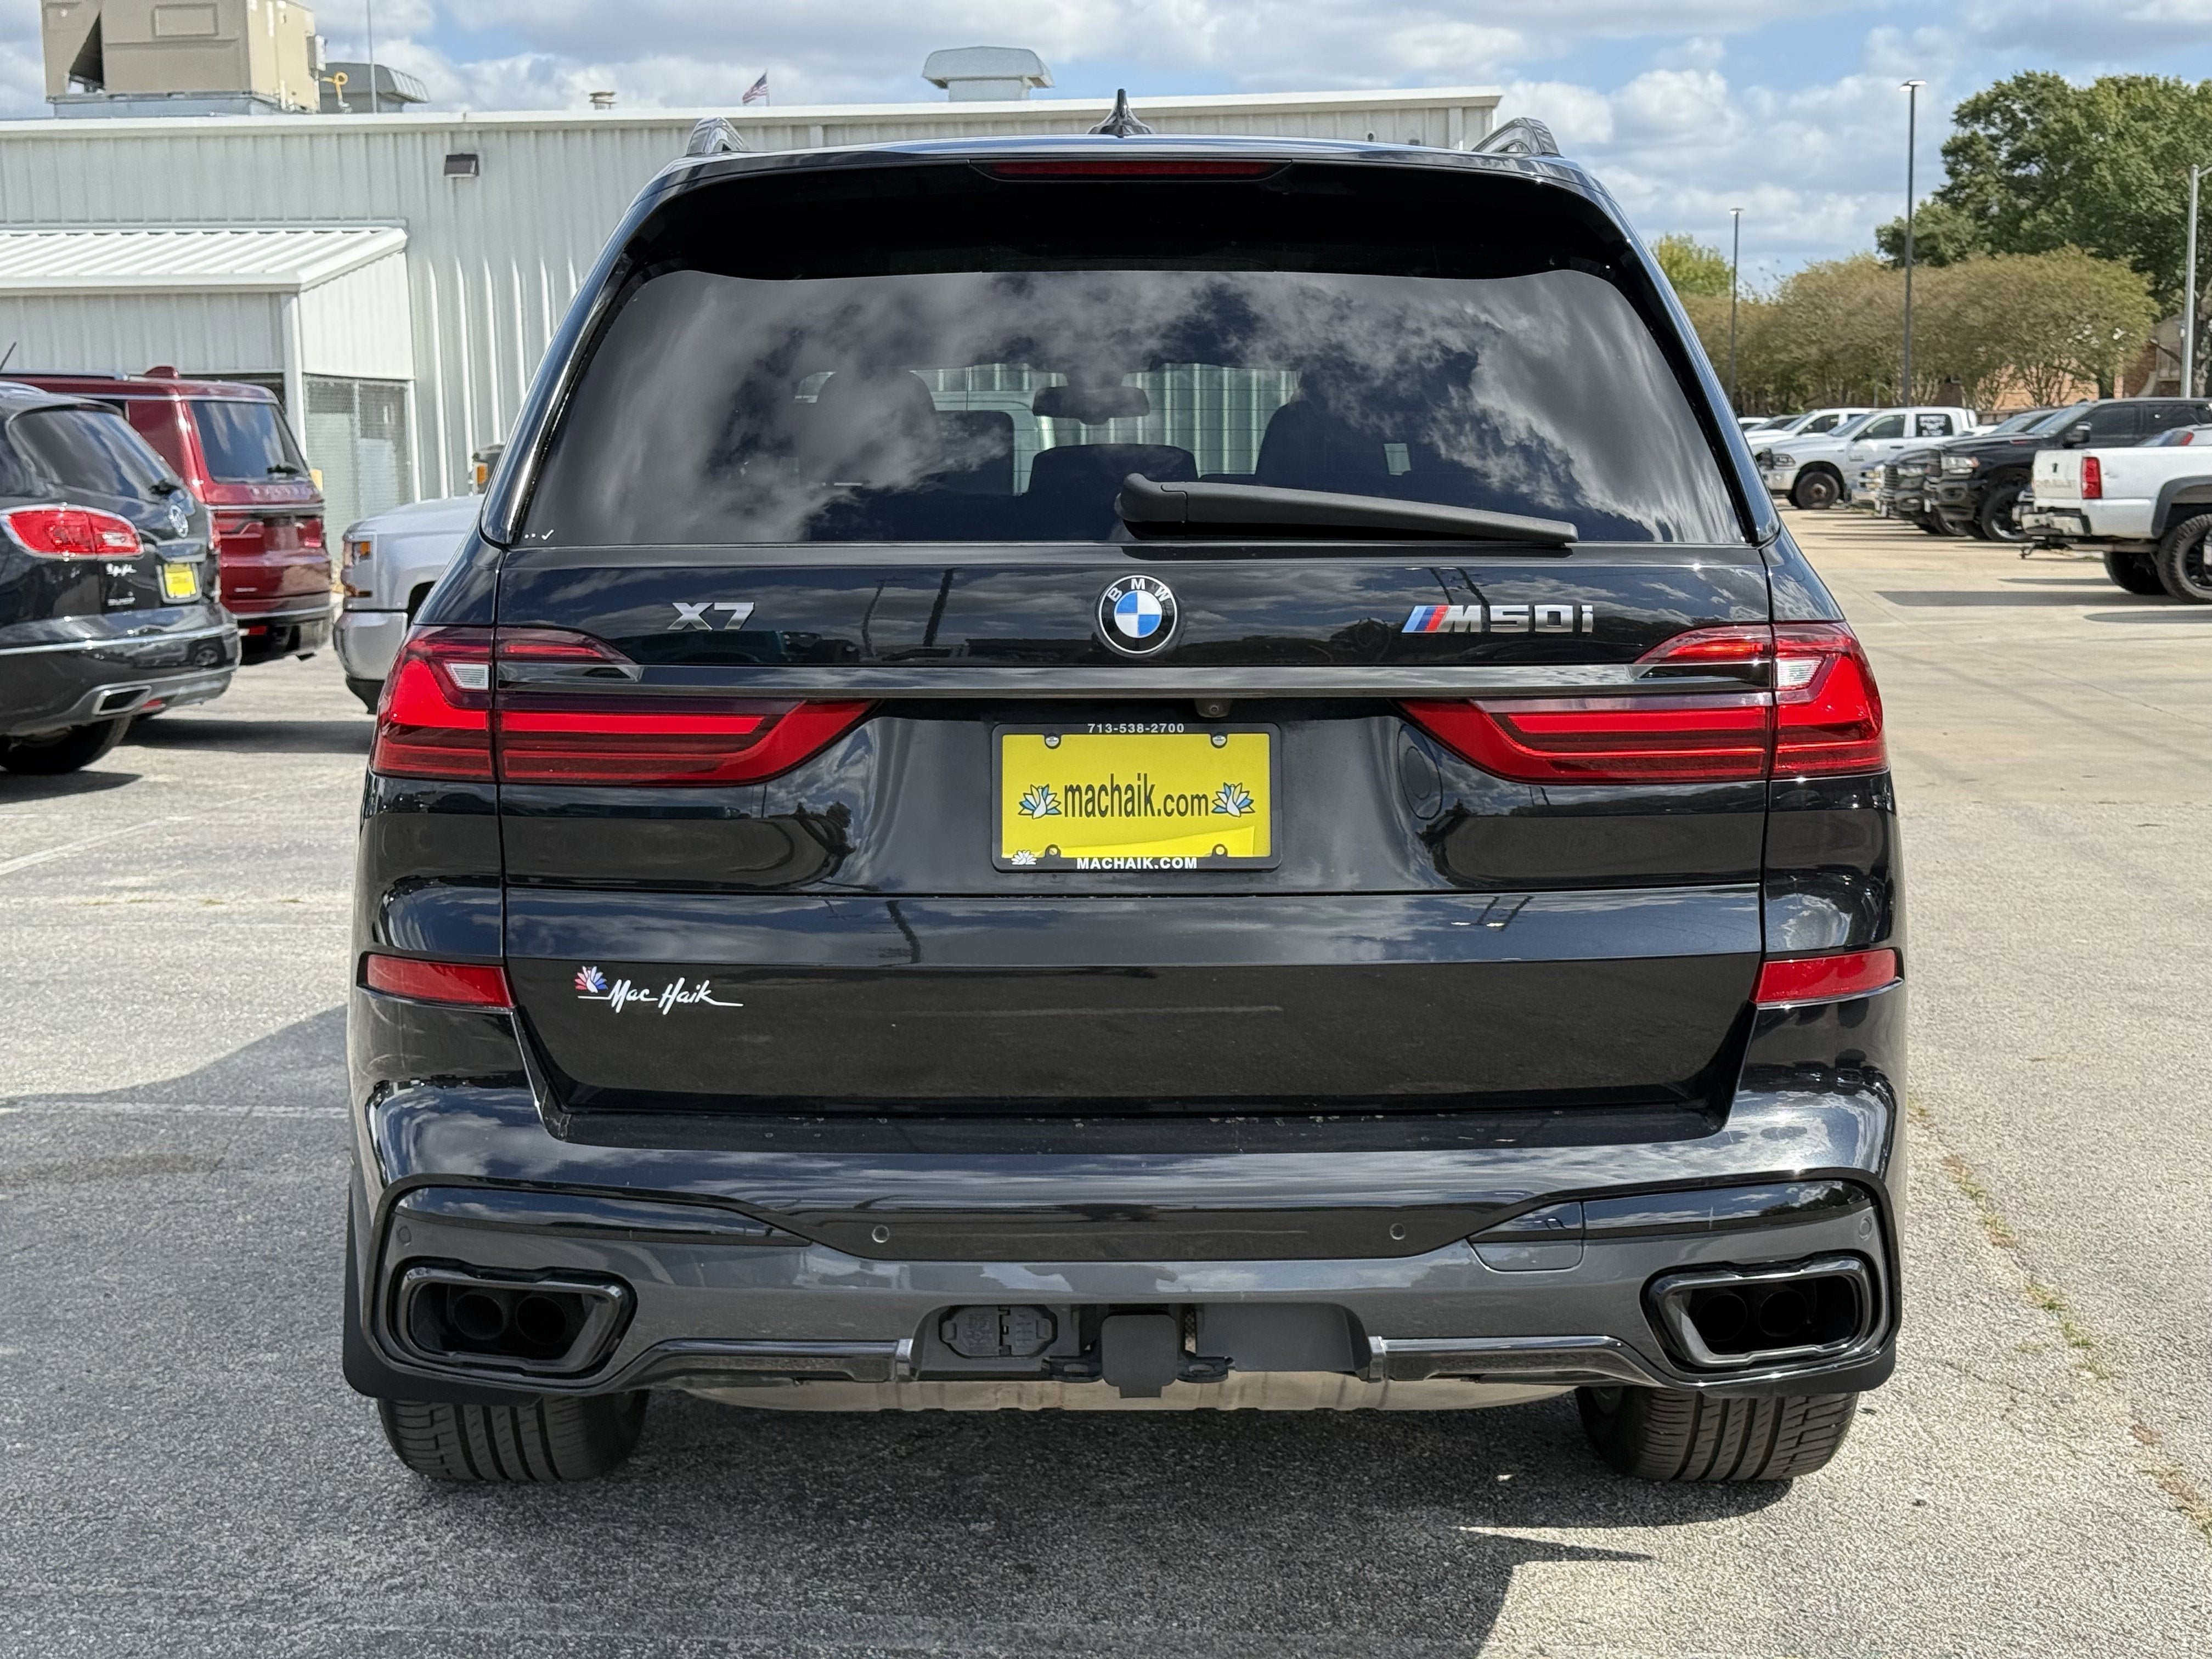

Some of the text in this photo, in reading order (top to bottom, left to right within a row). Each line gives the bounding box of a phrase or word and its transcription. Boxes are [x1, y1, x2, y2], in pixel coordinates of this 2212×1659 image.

[1107, 578, 1171, 602] BMW
[667, 602, 754, 630] X7
[1436, 605, 1593, 633] M50i
[1087, 724, 1184, 733] 713-538-2700
[1064, 773, 1209, 817] machaik.com
[1076, 857, 1197, 869] MACHAIK.COM
[578, 977, 744, 1015] Mac Haik
